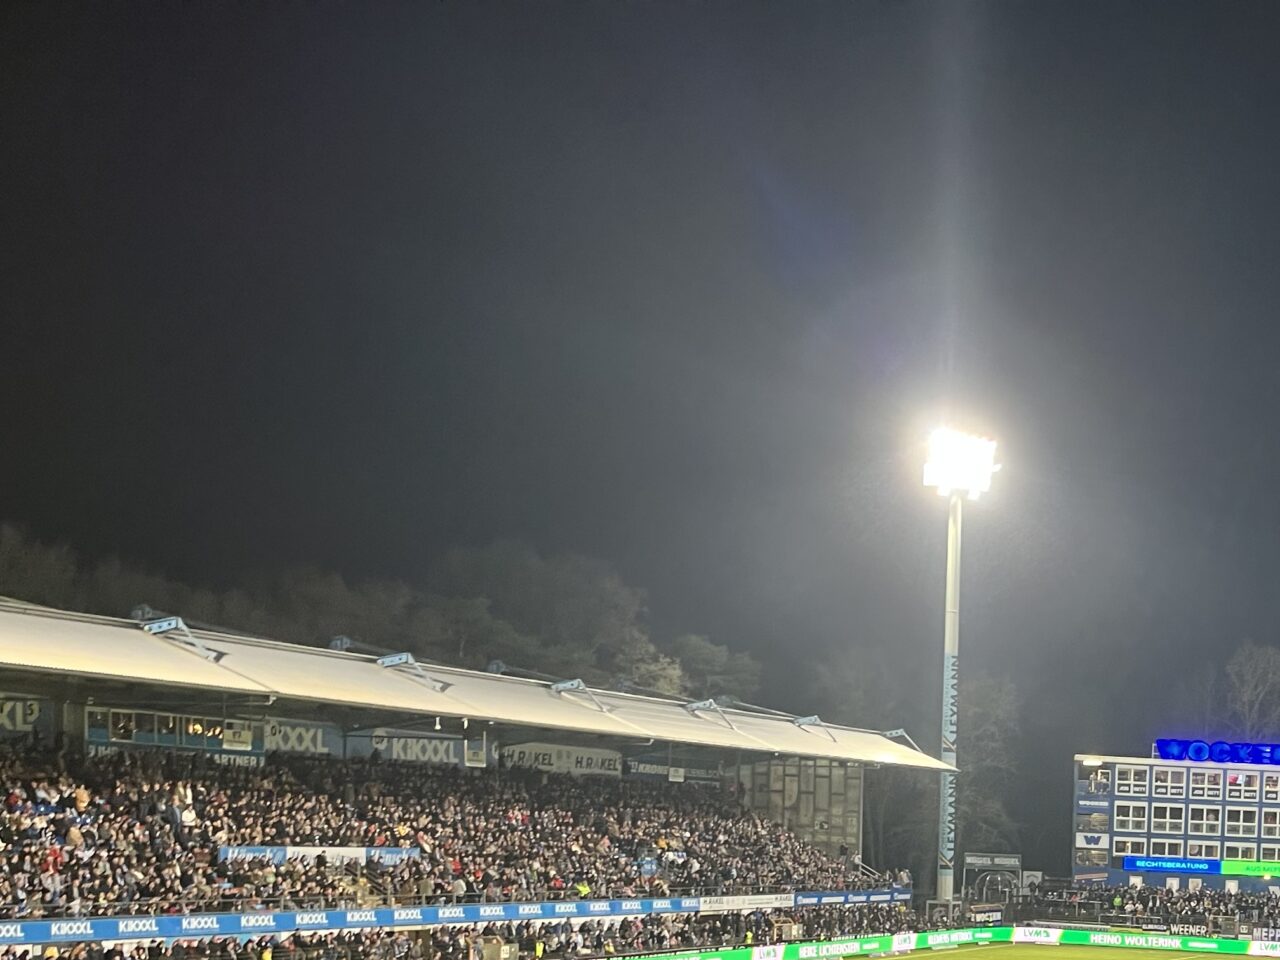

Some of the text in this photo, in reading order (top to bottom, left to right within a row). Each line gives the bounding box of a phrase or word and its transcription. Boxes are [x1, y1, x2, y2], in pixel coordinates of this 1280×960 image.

[1136, 860, 1209, 871] RECHTSBERATUNG
[1024, 929, 1042, 938] LVM
[1090, 933, 1122, 945] HEINO
[1124, 935, 1183, 949] WOLTERINK
[1260, 943, 1280, 951] LVM
